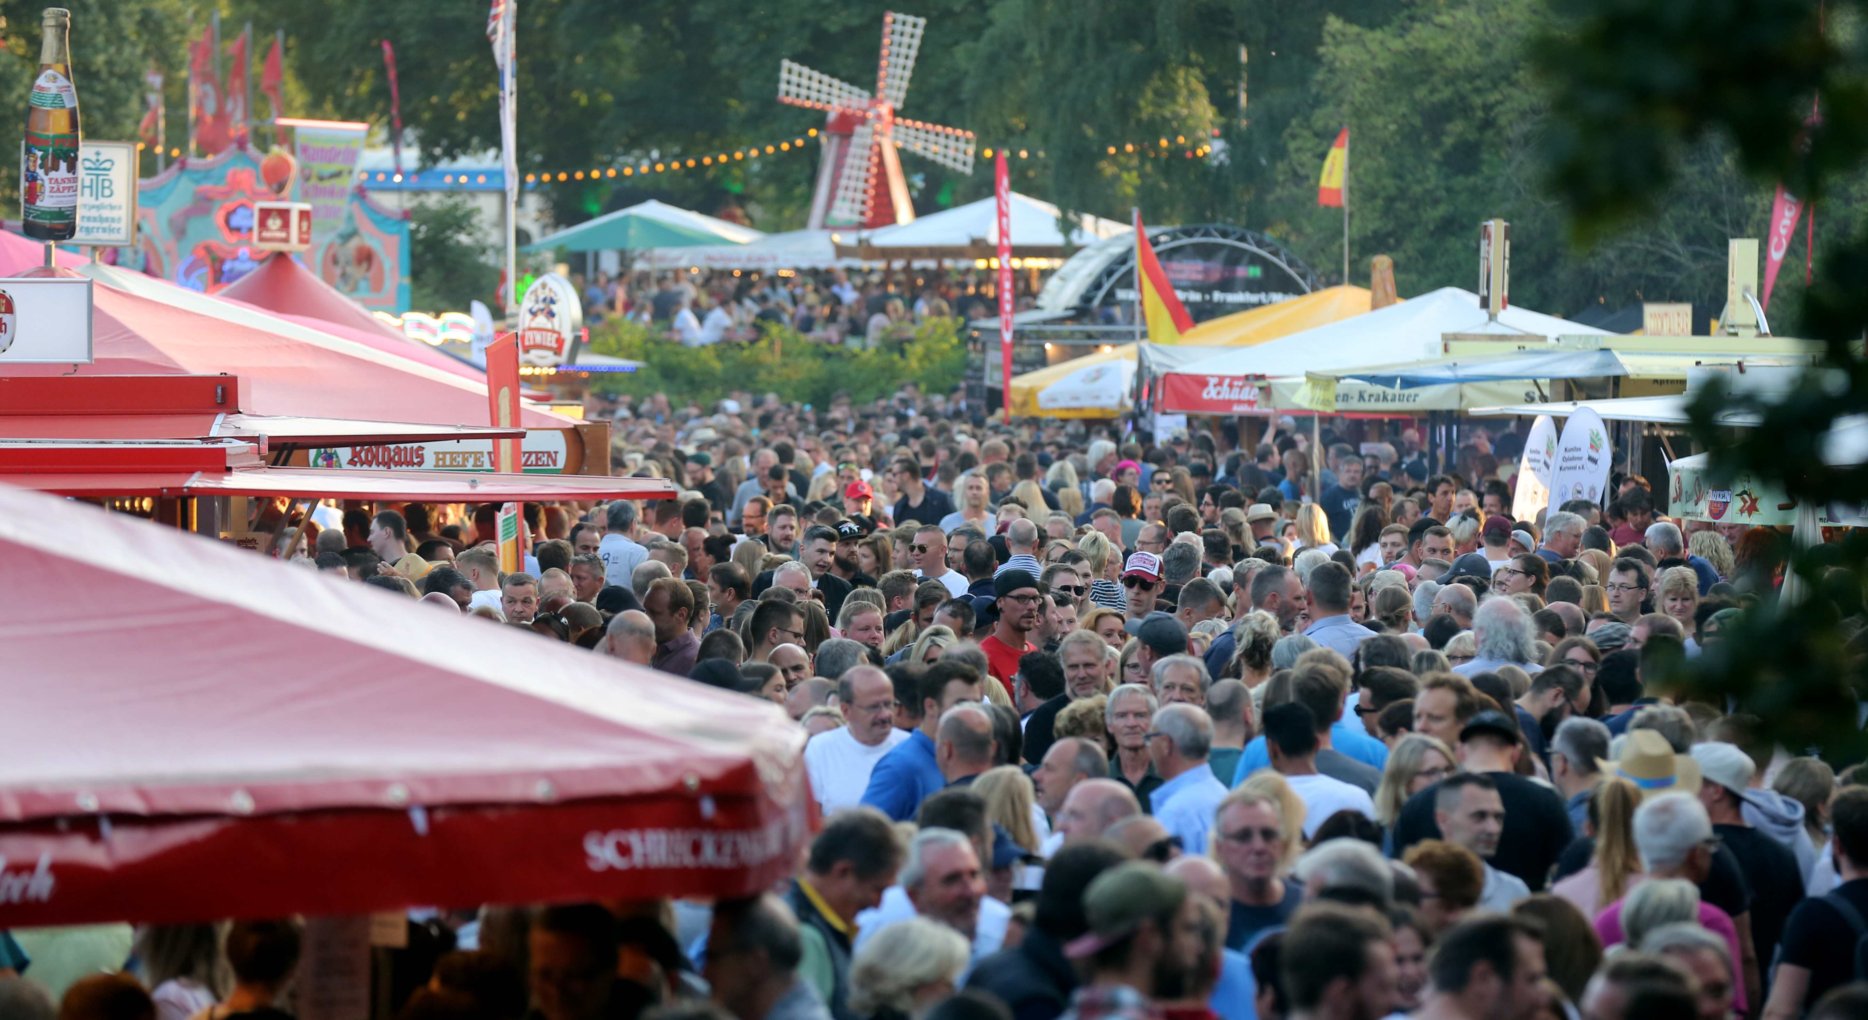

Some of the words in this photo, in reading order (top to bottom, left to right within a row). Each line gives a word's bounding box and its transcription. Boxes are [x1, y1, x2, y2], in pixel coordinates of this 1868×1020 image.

[48, 176, 78, 184] TANNE
[49, 185, 78, 193] ZÄPFL
[80, 214, 123, 224] rauhaus
[1201, 376, 1260, 400] Schäde
[1357, 389, 1419, 404] Krakauer
[433, 451, 485, 468] HEFE
